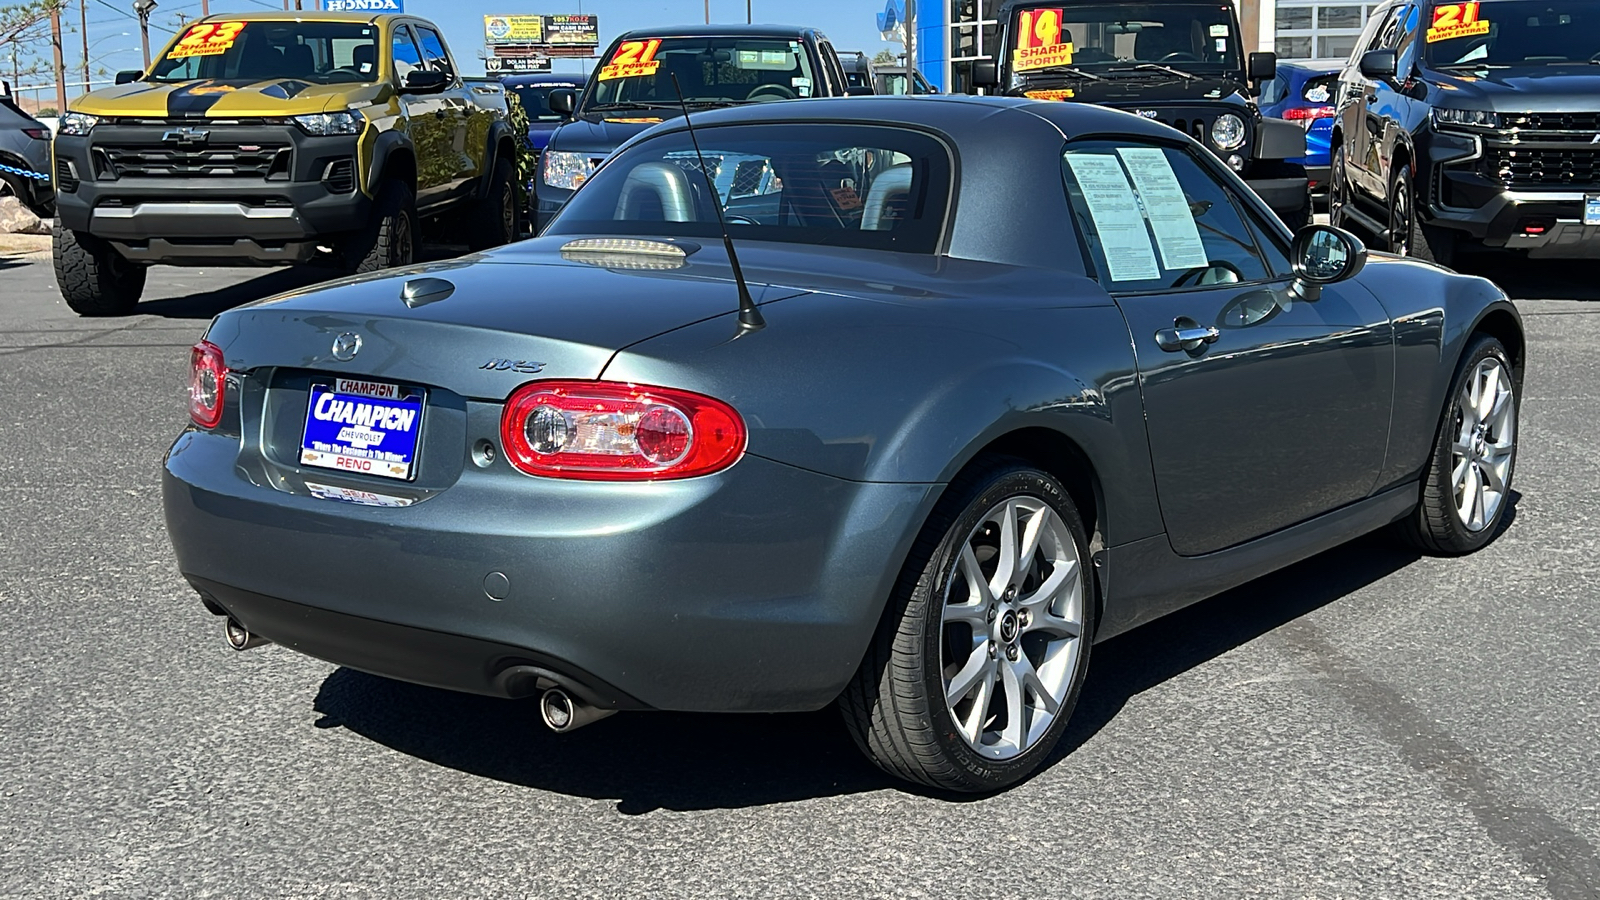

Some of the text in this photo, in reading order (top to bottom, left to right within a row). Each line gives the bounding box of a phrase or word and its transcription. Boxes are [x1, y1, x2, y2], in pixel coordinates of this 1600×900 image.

[328, 0, 399, 11] HONDA
[1433, 3, 1476, 27] 21
[180, 22, 243, 45] 23
[1018, 10, 1059, 49] 14
[1429, 27, 1487, 40] MANY EXTRAS
[1435, 23, 1472, 33] WOW
[181, 41, 228, 51] SHARP
[613, 40, 658, 64] 21
[1020, 44, 1067, 58] SHARP
[1017, 55, 1067, 68] SPORTY
[478, 358, 547, 374] MX-5
[340, 380, 395, 397] CHAMPION
[314, 392, 416, 432] CHAMPION
[341, 429, 381, 442] CHEVROLET
[332, 444, 341, 453] The
[342, 446, 367, 457] Customer
[375, 450, 384, 459] The
[336, 457, 371, 470] RENO
